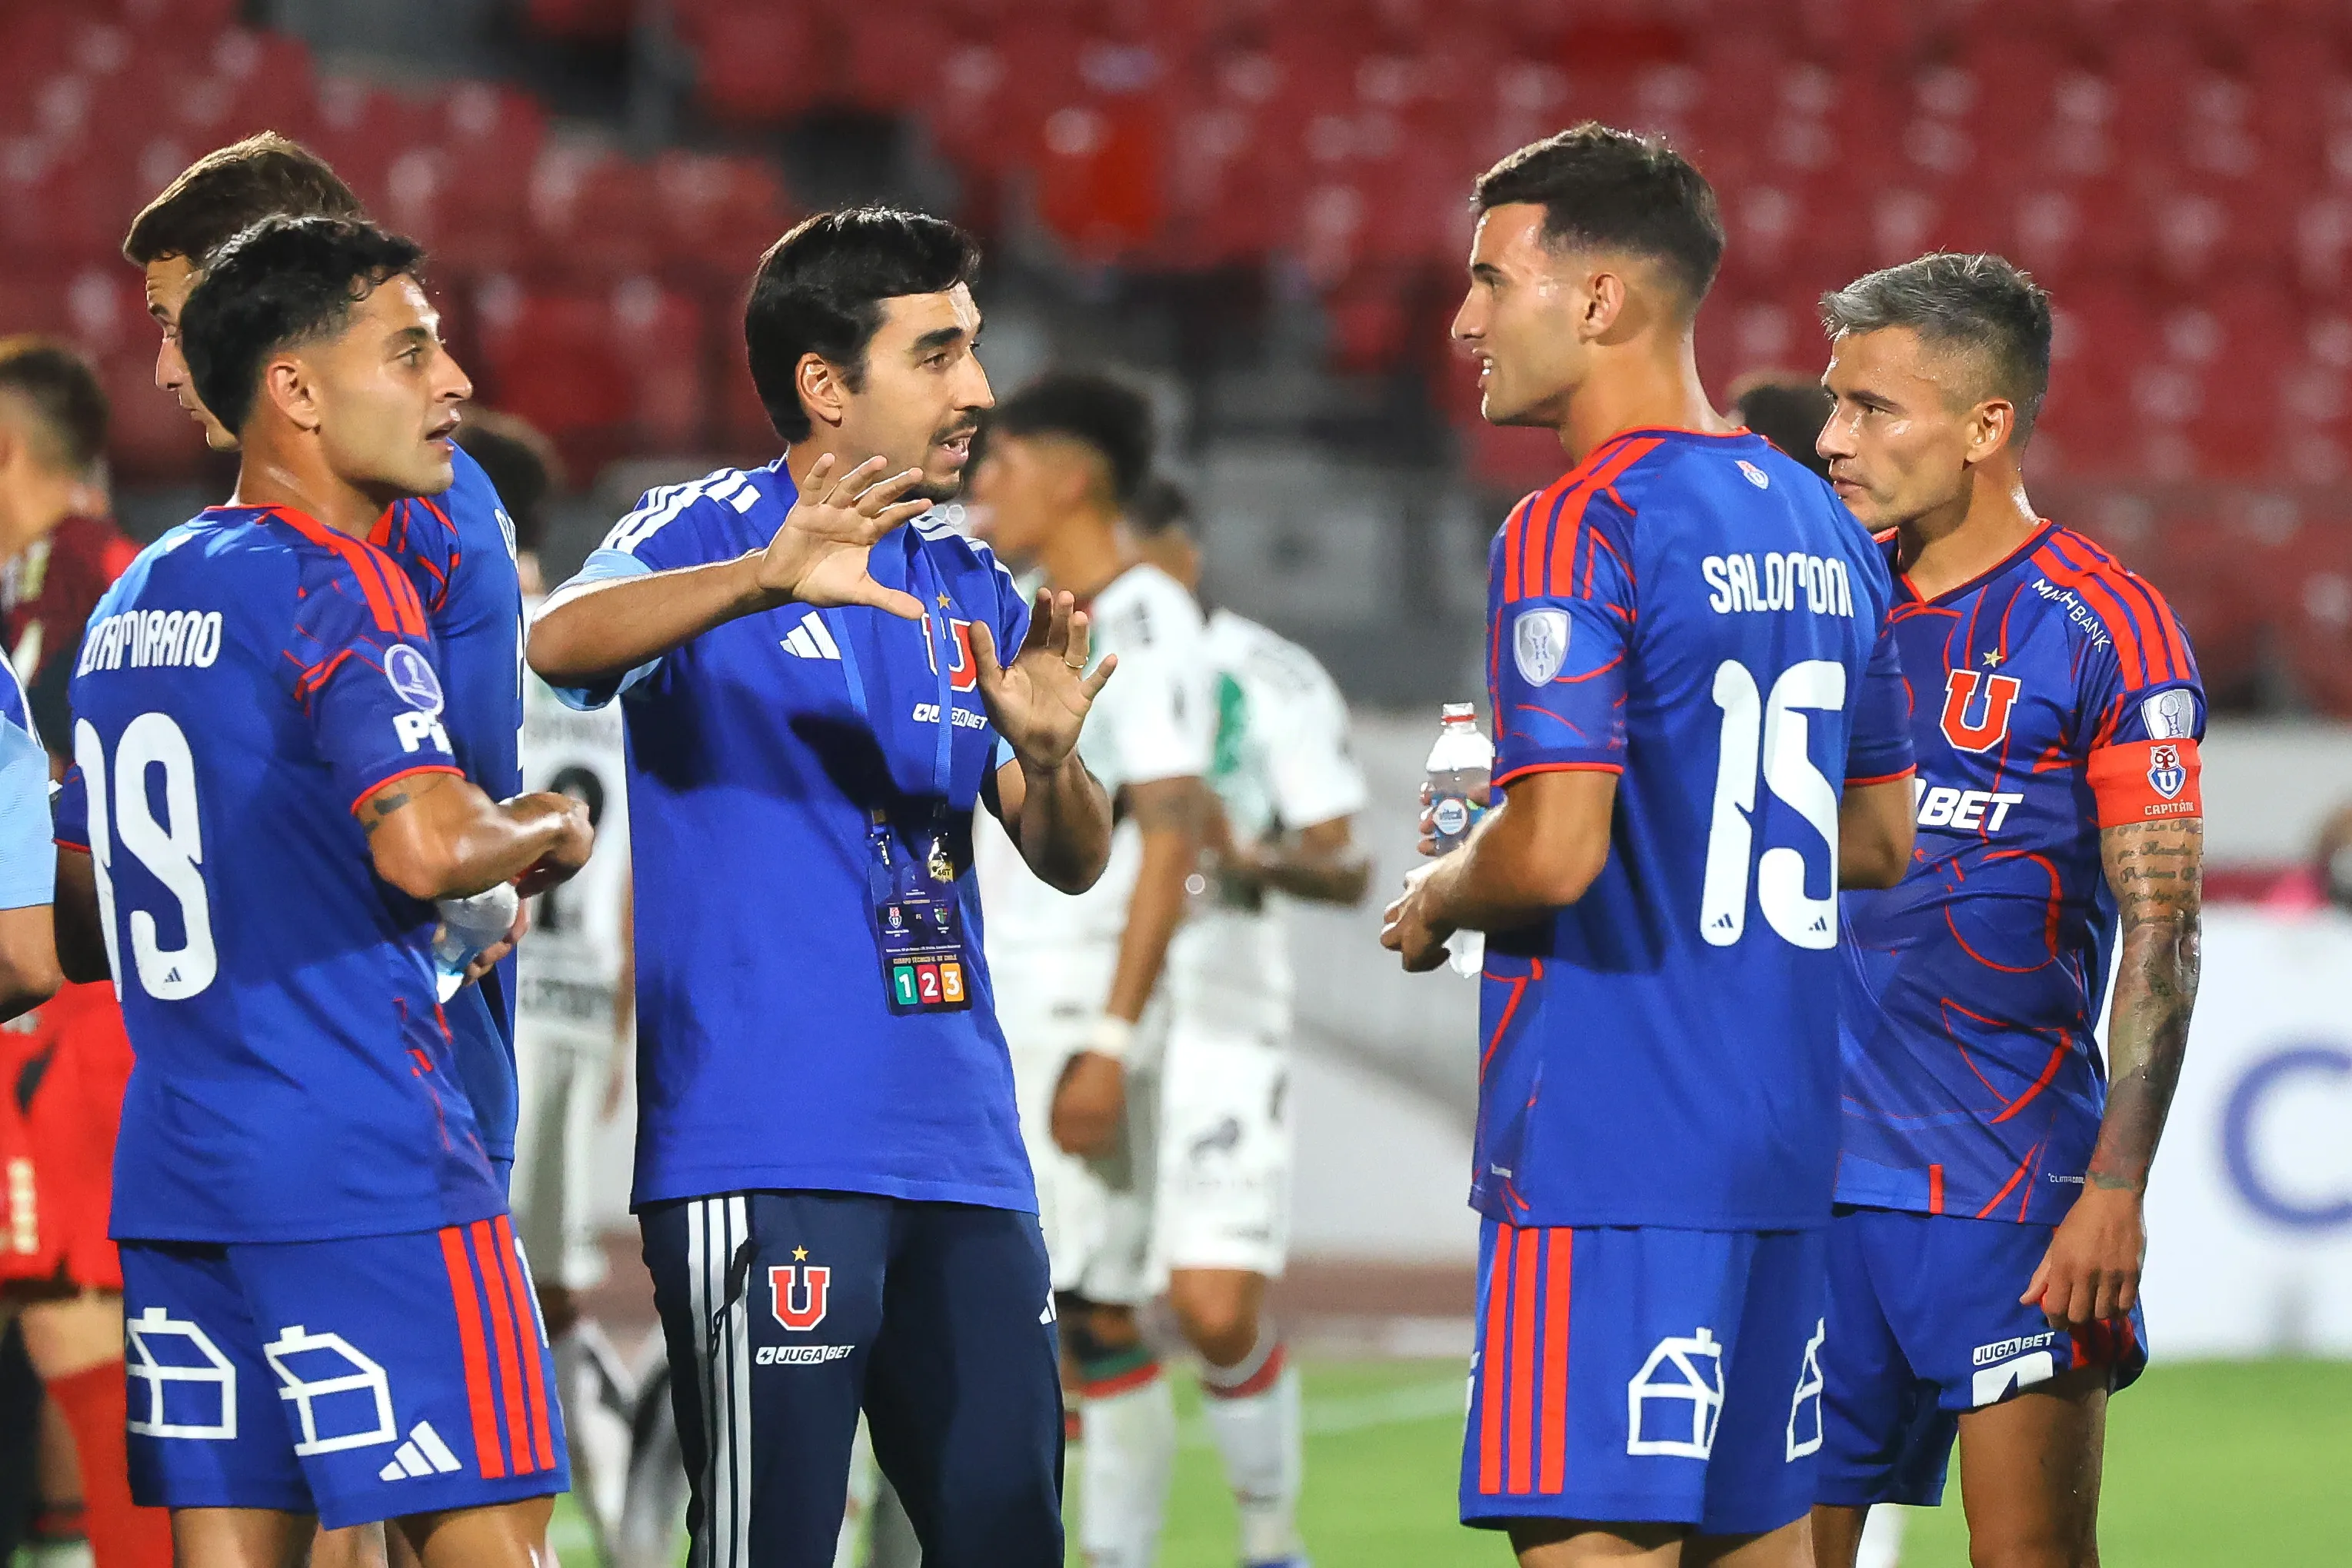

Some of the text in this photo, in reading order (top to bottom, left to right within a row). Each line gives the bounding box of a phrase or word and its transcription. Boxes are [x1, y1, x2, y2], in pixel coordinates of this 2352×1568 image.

[1702, 552, 1854, 618] SALOMONI
[928, 705, 988, 730] JGABET
[1940, 668, 2021, 754] U
[1700, 659, 1846, 950] 15
[1916, 786, 2024, 831] BET
[75, 712, 218, 1001] 19
[899, 971, 961, 998] 1 2 3
[768, 1266, 831, 1331] U
[775, 1345, 855, 1363] JUGABET
[1974, 1332, 2055, 1365] JUGABET
